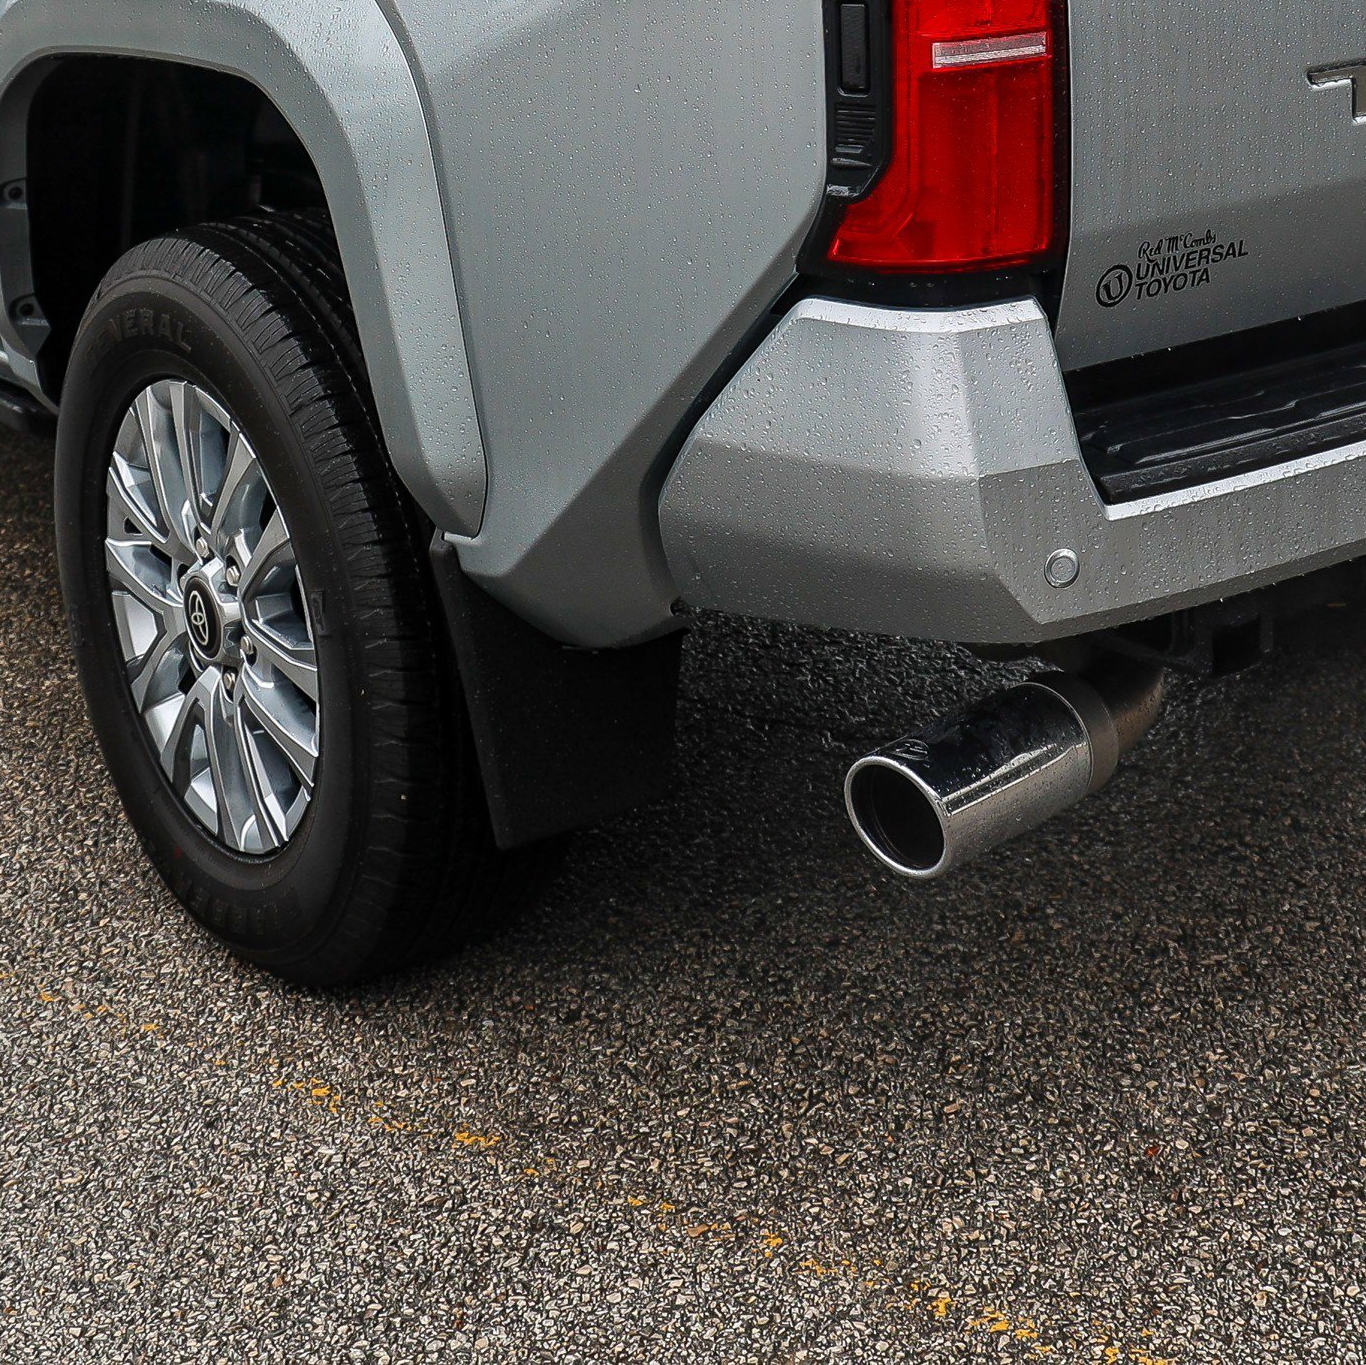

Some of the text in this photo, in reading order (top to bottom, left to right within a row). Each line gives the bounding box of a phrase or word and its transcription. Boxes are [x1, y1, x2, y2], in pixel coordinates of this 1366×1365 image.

[1136, 239, 1249, 281] UNIVERSAL
[1138, 239, 1164, 263] Red
[1135, 267, 1211, 300] TOYOTA
